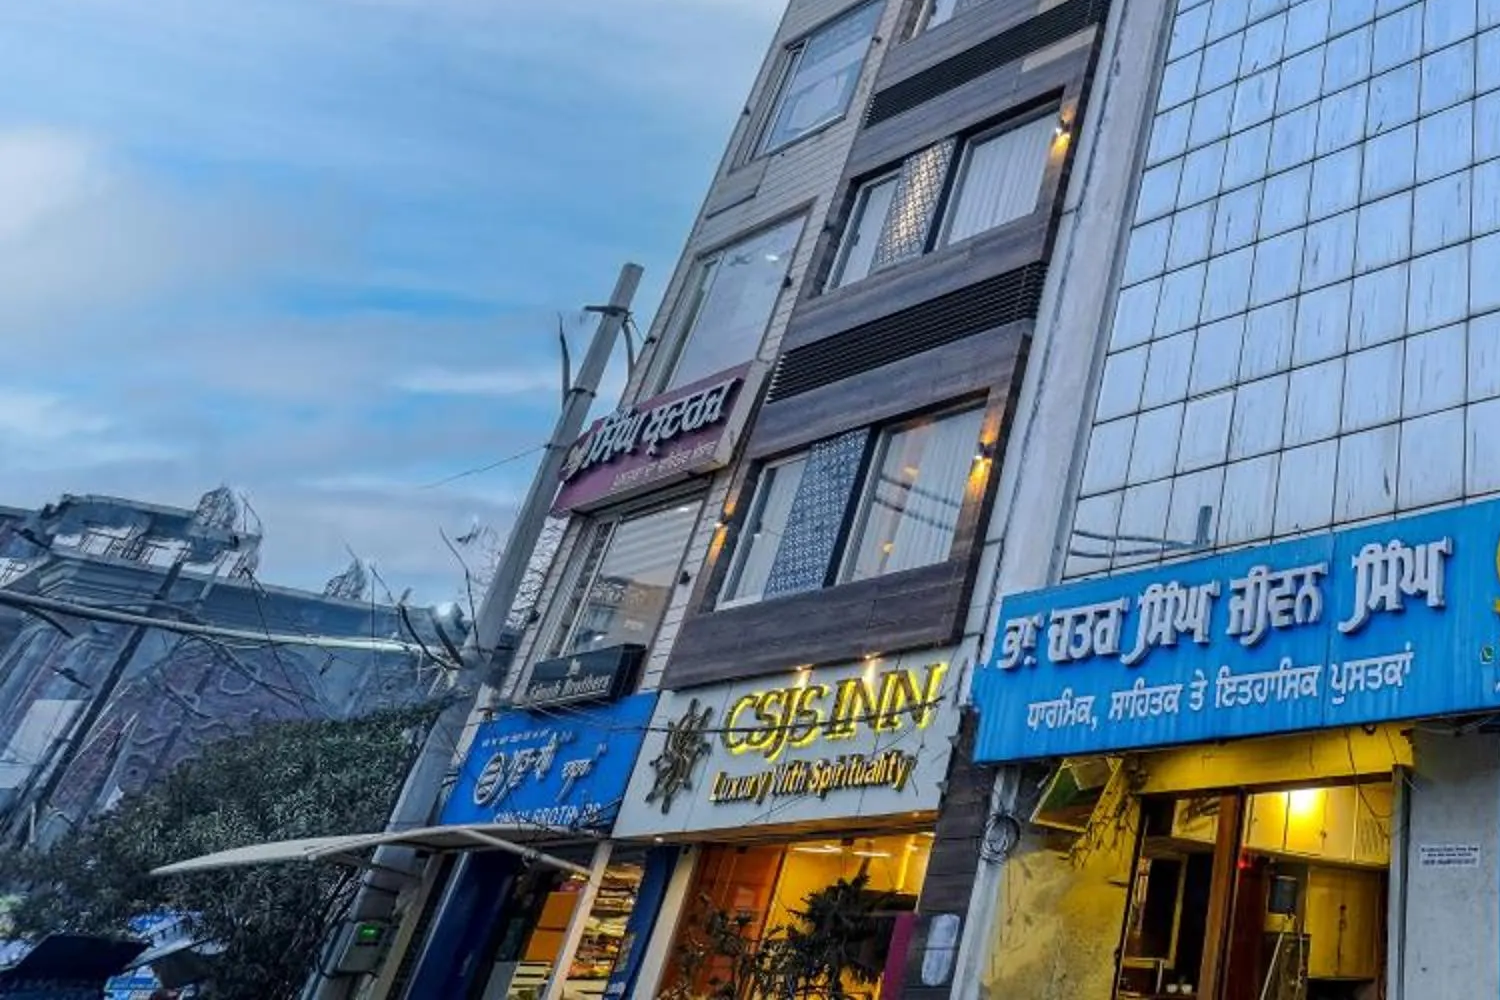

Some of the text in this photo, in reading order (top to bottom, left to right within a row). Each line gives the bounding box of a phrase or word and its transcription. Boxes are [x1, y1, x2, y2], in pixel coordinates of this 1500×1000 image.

[1047, 596, 1130, 663] ਚਤਰ
[1120, 580, 1220, 666] ਸਿੰਘ
[1225, 561, 1328, 648] ਜੀਵਨ
[1338, 536, 1453, 634] ਸਿੰਘ
[723, 663, 948, 761] CSJS INN
[1188, 668, 1208, 712] ਤੇ
[709, 771, 768, 806] Luxury
[808, 750, 916, 799] Spirituality
